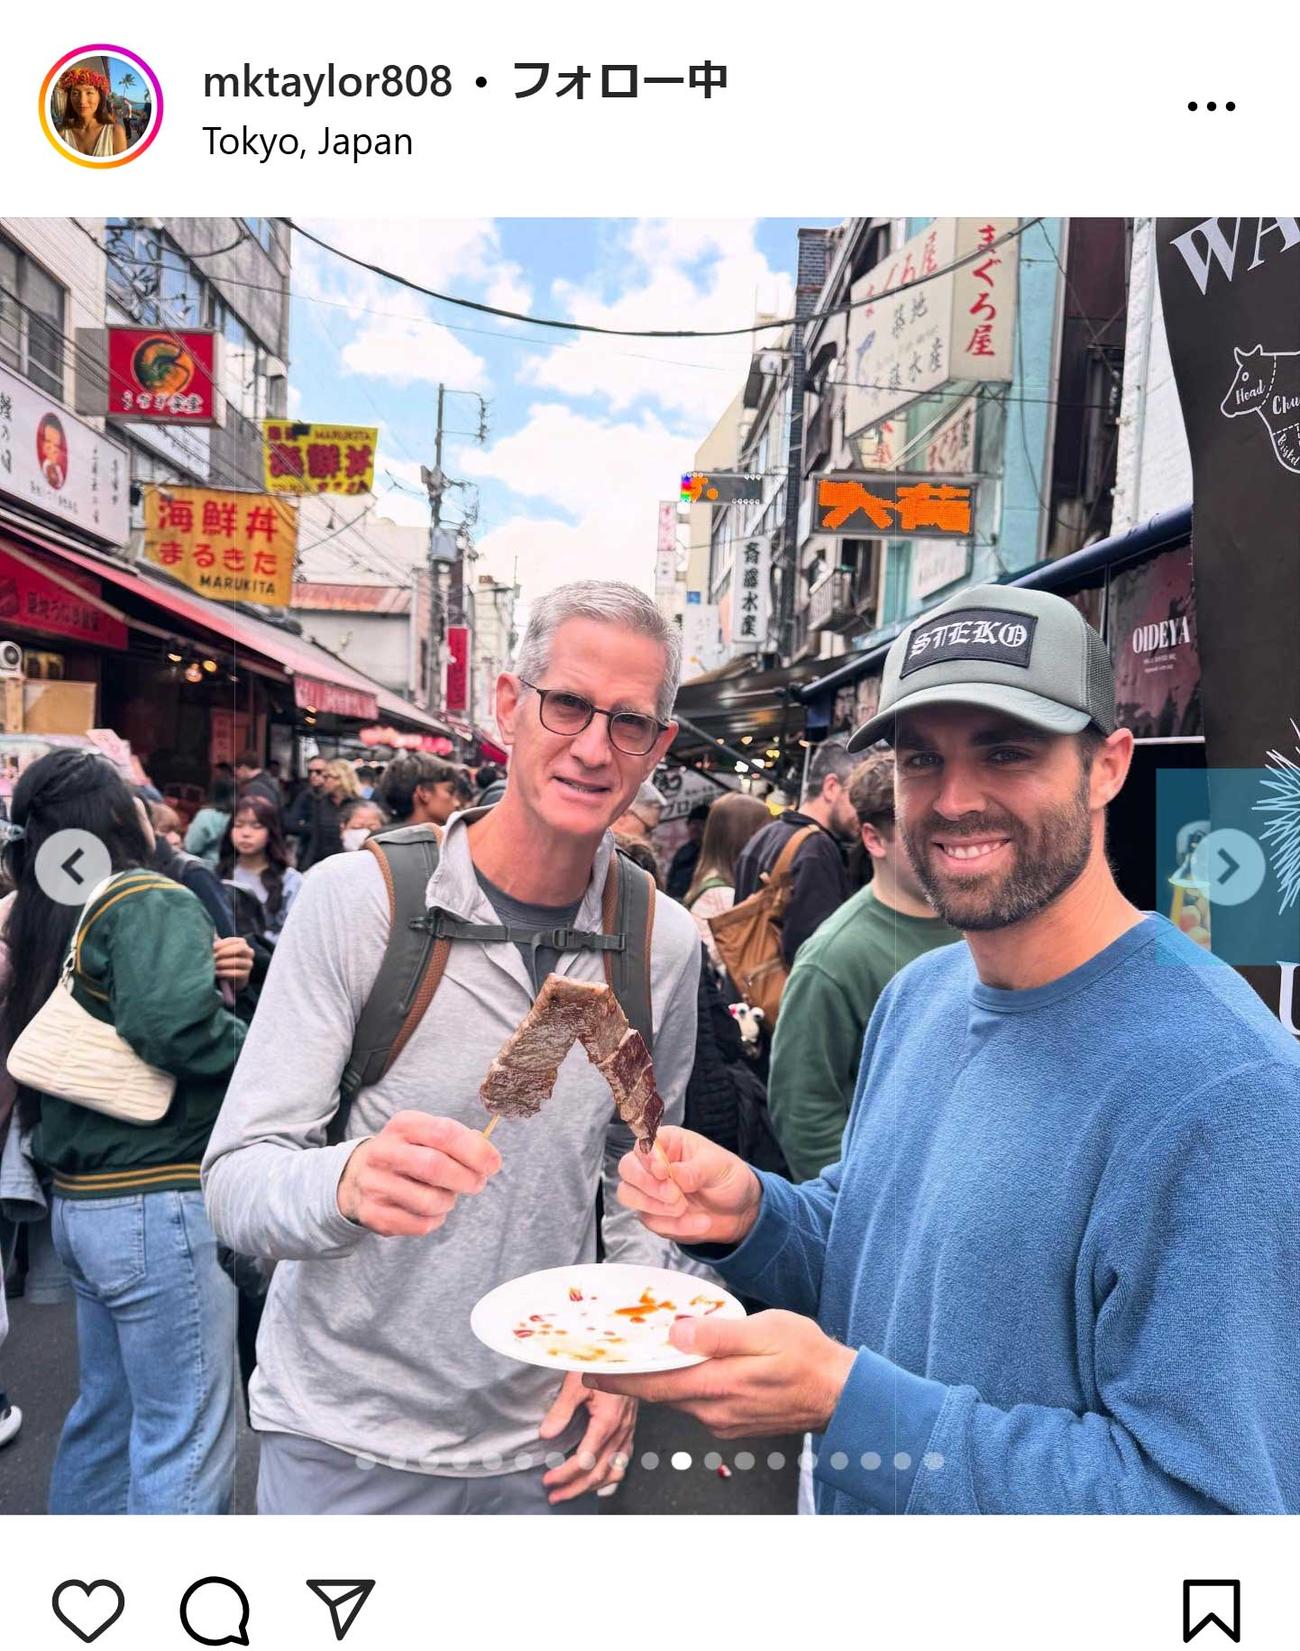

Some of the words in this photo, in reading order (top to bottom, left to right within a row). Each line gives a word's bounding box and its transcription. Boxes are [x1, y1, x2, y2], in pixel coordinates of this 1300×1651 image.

[965, 225, 1002, 357] まぐろ屋
[1235, 379, 1266, 404] Head
[157, 498, 279, 543] 海鮮丼
[159, 540, 277, 577] まるきた
[199, 575, 276, 594] MARUKITA
[1132, 615, 1191, 654] OIDEYA
